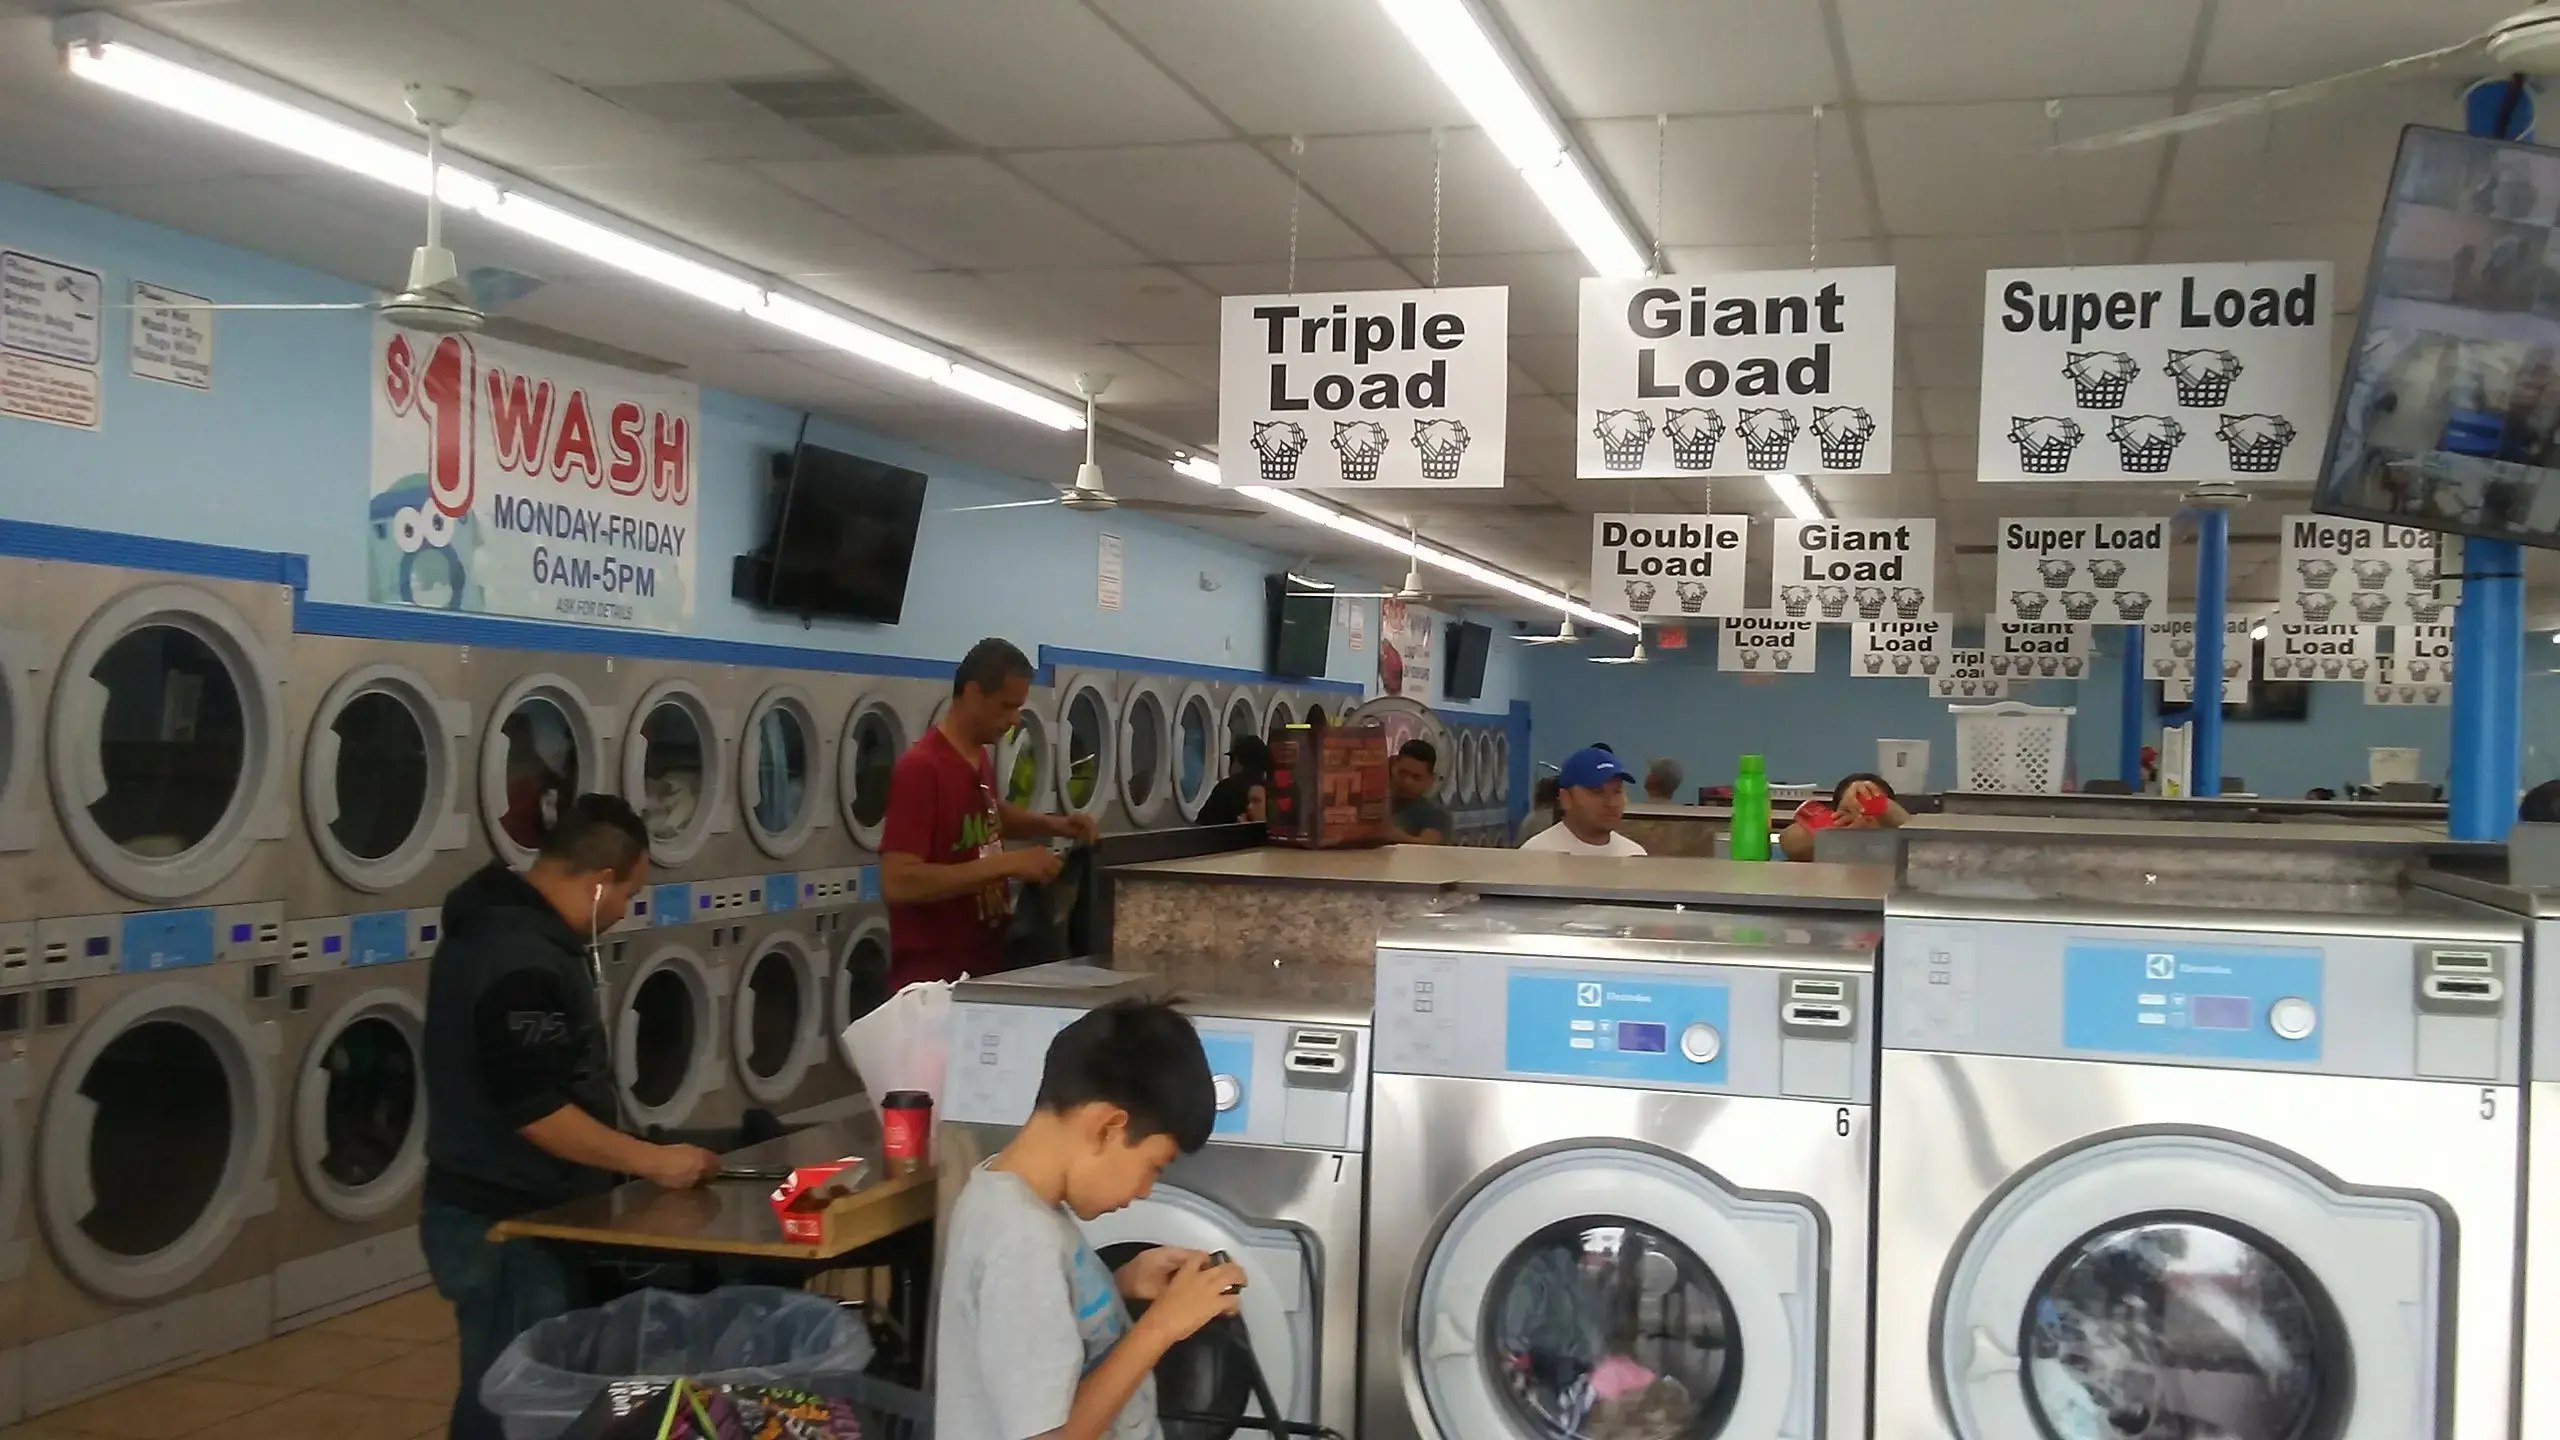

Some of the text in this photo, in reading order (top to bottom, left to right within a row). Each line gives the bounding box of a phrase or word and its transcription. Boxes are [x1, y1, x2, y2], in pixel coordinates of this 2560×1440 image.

[1627, 282, 1844, 339] Giant
[2002, 274, 2317, 344] Super Load
[1254, 302, 1465, 364] Triple
[1638, 344, 1830, 398] Load
[1270, 360, 1447, 410] Load
[485, 366, 690, 506] WASH
[494, 494, 685, 556] MONDAY-FRIDAY
[1602, 522, 1739, 549] Double
[1799, 524, 1910, 551] Giant
[2294, 522, 2434, 555] Mega Loa
[2007, 523, 2161, 555] Super Load
[533, 546, 655, 597] 6AM-5PM
[1617, 550, 1712, 577] Load
[1803, 555, 1903, 581] Load
[1725, 617, 1812, 630] Double
[2150, 620, 2192, 637] Supe
[2415, 626, 2453, 642] Tri
[1735, 631, 1795, 648] Load
[1870, 636, 1932, 652] Load
[2005, 637, 2069, 653] Load
[2286, 638, 2354, 655] Load
[2415, 641, 2449, 657] Lo
[1952, 651, 1984, 666] ripl
[2481, 1088, 2495, 1120] 5
[1837, 1107, 1849, 1137] 6
[1332, 1155, 1343, 1182] 7
